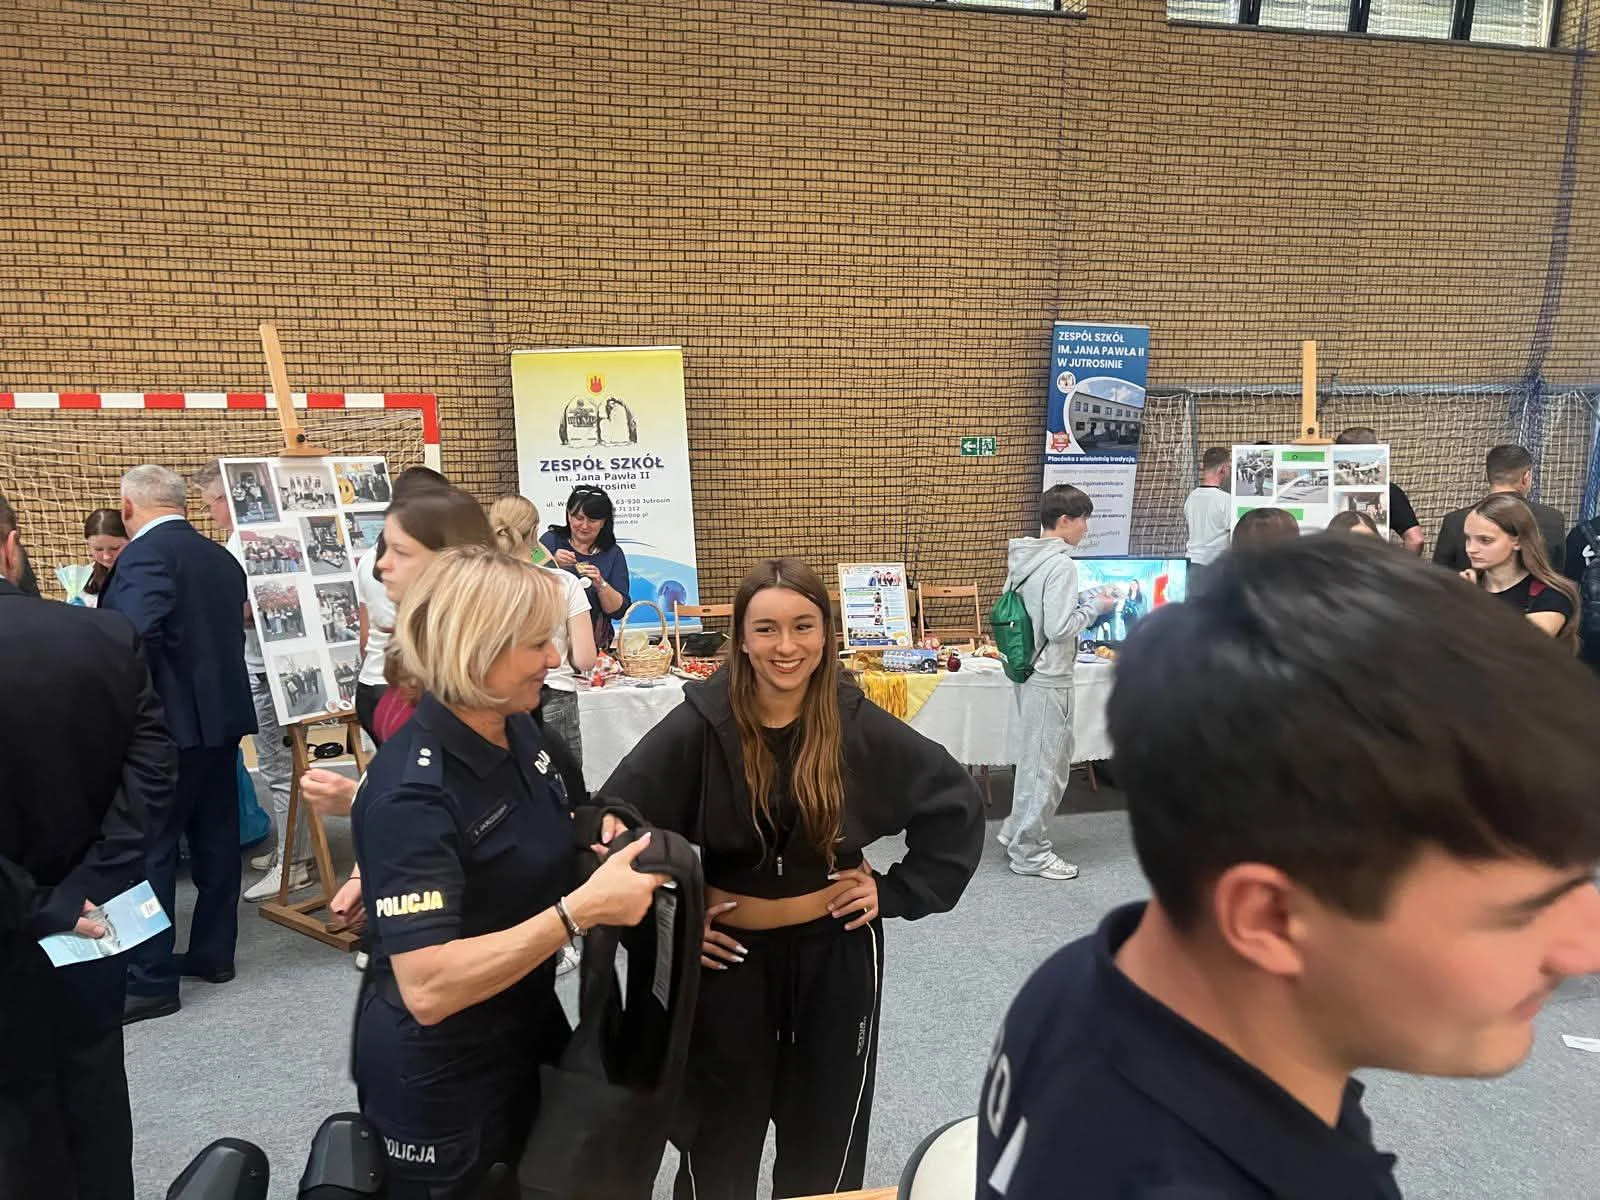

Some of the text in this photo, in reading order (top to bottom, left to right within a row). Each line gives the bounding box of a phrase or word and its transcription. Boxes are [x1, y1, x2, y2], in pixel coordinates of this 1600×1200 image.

[1058, 330, 1125, 343] ZESPÓŁ SZKÓŁ
[1057, 345, 1145, 357] IM. JANA PAWŁA II
[1057, 358, 1123, 369] W JUTROSINIE
[540, 453, 664, 472] ZESPÓŁ SZKÓŁ
[555, 471, 650, 483] im. Jana Pawła II
[596, 482, 637, 491] trosinie
[376, 890, 444, 918] POLICJA
